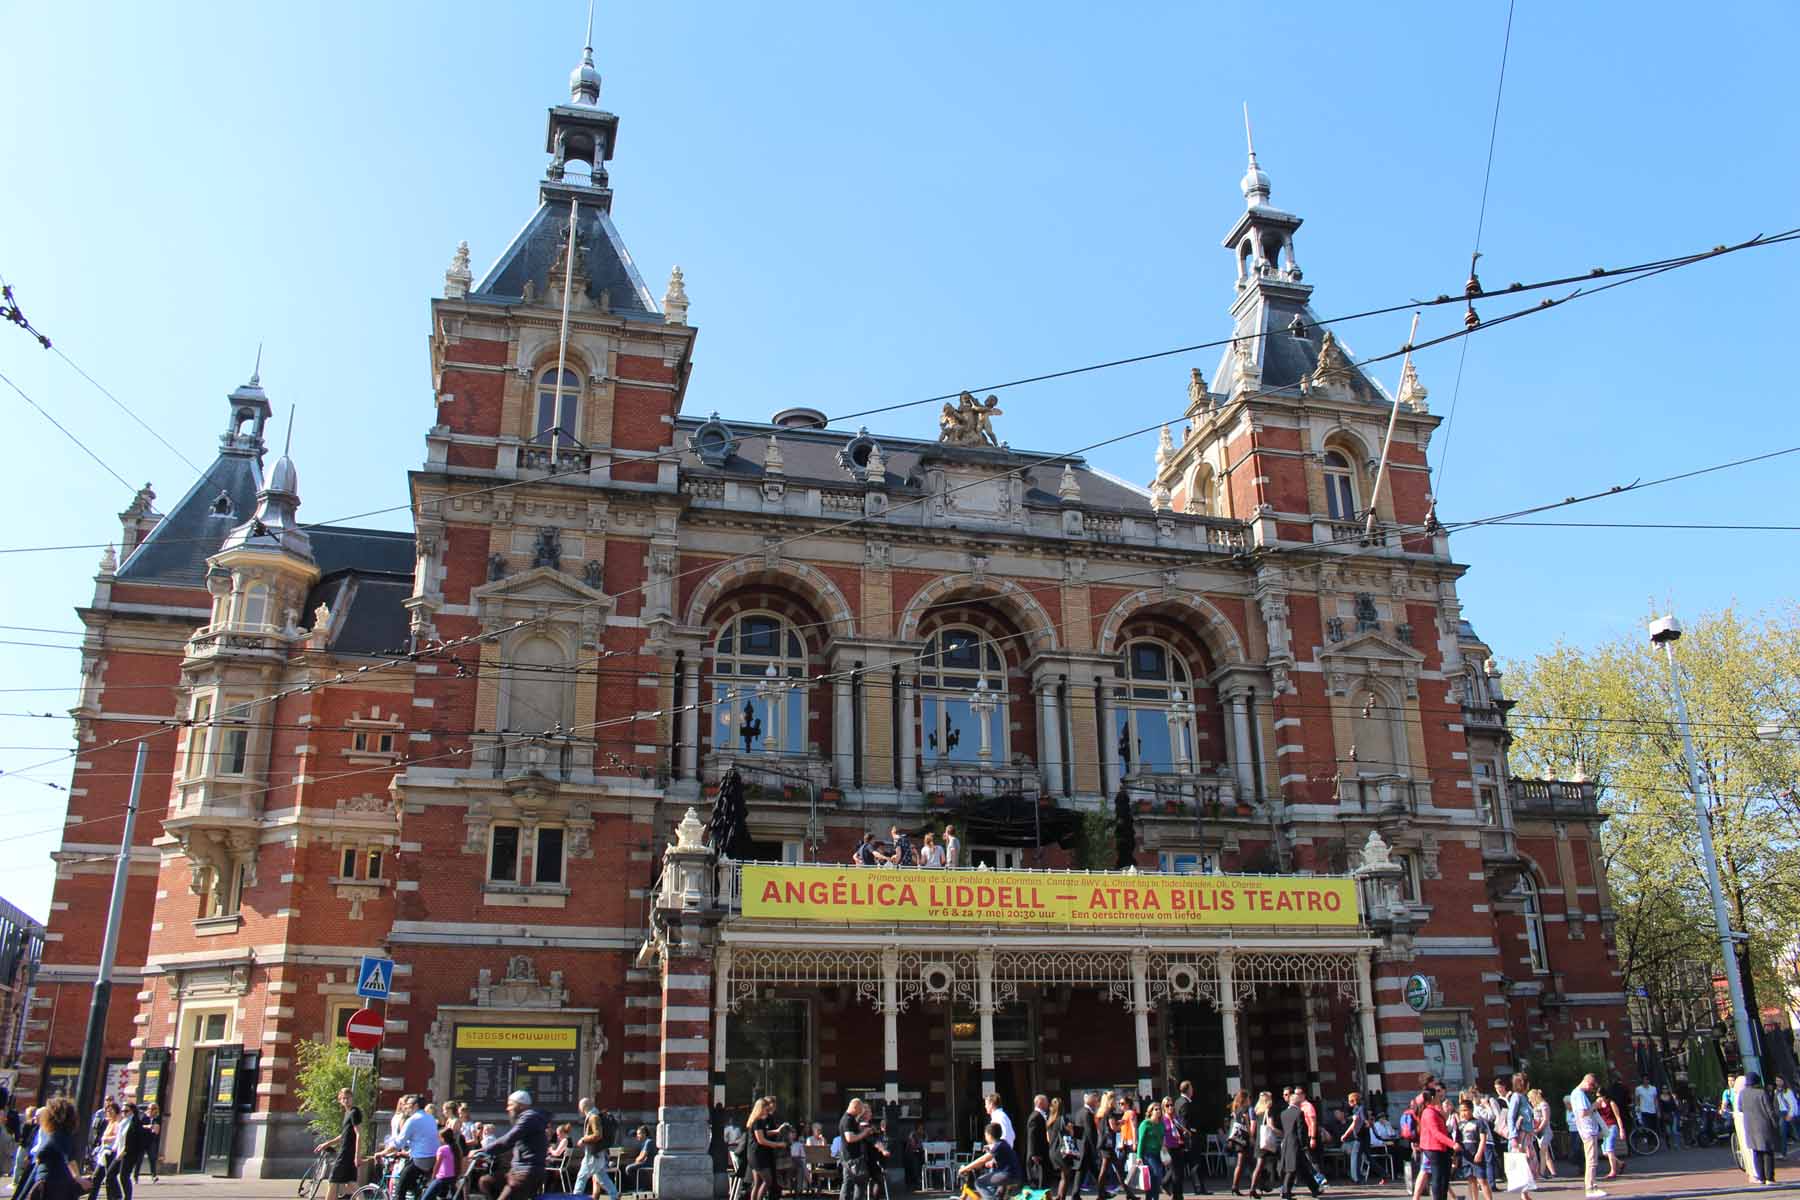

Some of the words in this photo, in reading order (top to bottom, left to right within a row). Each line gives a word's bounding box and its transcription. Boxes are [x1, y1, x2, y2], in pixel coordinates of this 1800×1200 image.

[761, 876, 918, 906] ANGÉLICA
[930, 884, 1045, 908] LIDDELL
[1089, 888, 1160, 910] ATRA
[1171, 889, 1235, 911] BILIS
[1243, 890, 1341, 912] TEATRO
[942, 908, 949, 916] 6
[962, 909, 973, 917] za
[985, 910, 1004, 918] mei
[1007, 910, 1036, 920] 20:30
[1039, 911, 1056, 919] uur
[1072, 911, 1089, 919] Een
[1092, 911, 1154, 920] oerschreeuw
[1174, 911, 1202, 921] liefde
